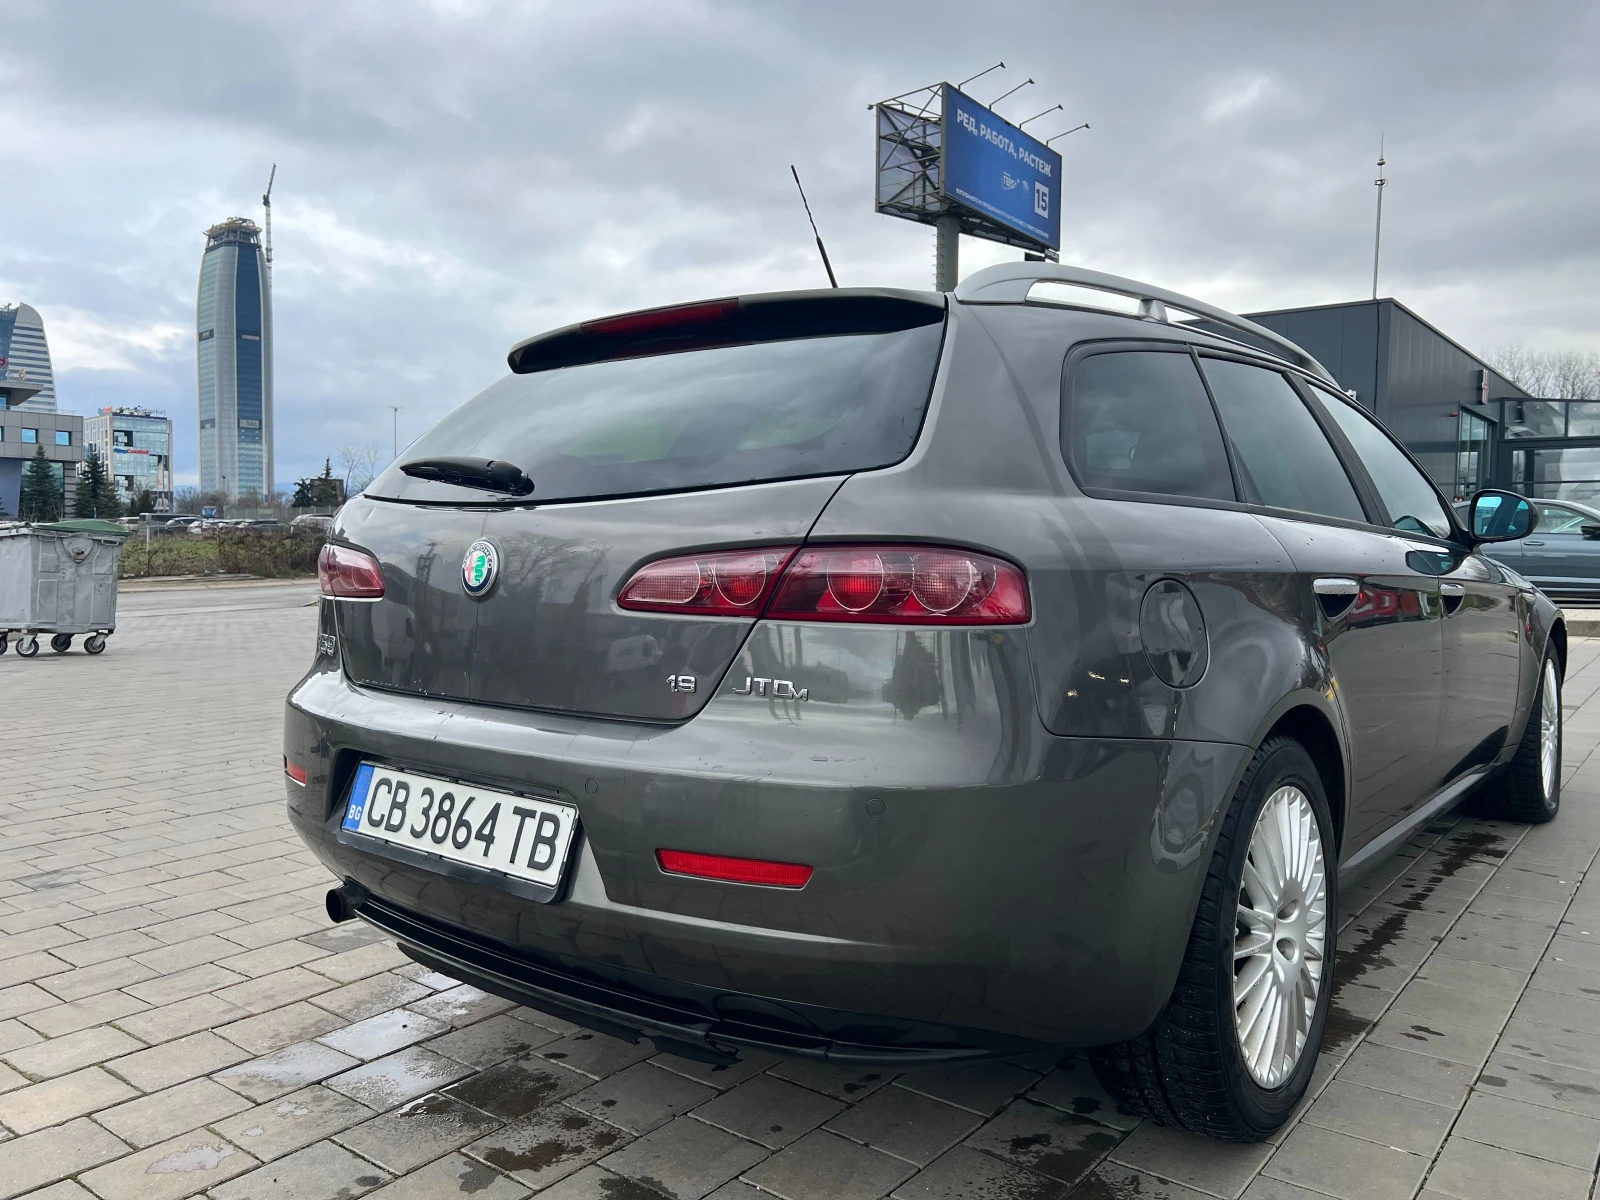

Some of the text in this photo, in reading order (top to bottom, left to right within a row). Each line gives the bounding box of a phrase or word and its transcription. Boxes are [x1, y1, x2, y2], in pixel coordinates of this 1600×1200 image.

[957, 109, 1052, 177] РЕД, РАБОТА, РАСТЕЖ
[1036, 188, 1048, 211] 15
[348, 804, 363, 821] BG
[367, 777, 561, 871] CB 3864 TB
